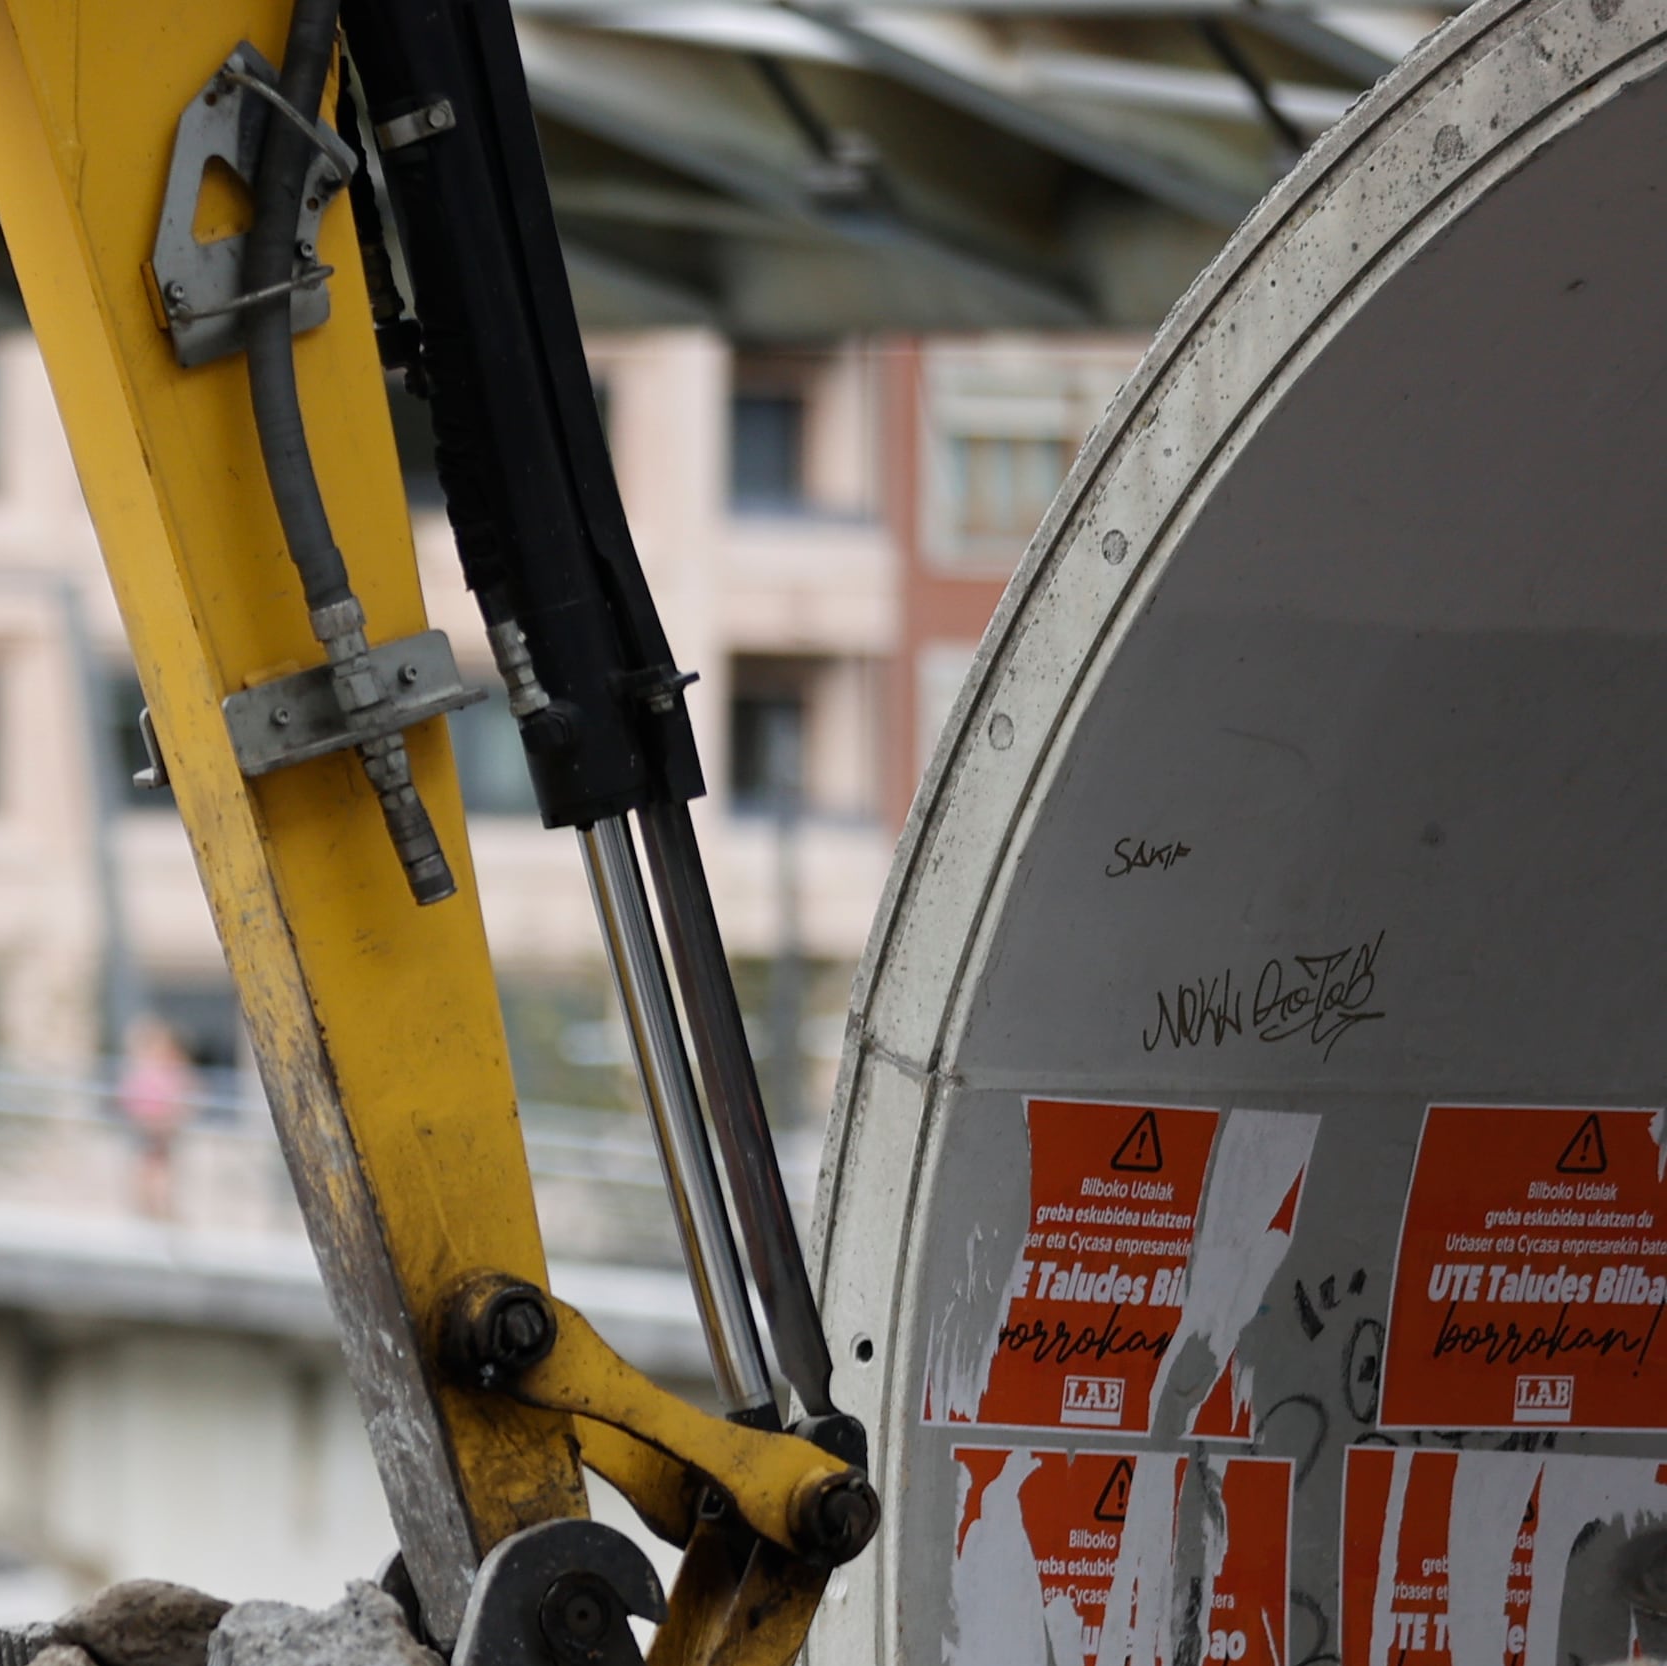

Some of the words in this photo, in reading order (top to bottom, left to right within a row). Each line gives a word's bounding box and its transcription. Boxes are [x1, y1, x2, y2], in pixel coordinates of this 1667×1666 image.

[1080, 1177, 1129, 1199] Bilboko
[1130, 1180, 1174, 1200] Udalak
[1527, 1181, 1572, 1200] Bilboko
[1576, 1182, 1618, 1201] Udalak
[1036, 1203, 1073, 1225] greba
[1075, 1205, 1139, 1227] eskubidea
[1142, 1208, 1191, 1229] ukatzen
[1485, 1208, 1521, 1230] greba
[1522, 1208, 1585, 1227] eskubidea
[1586, 1211, 1635, 1228] ukatzen
[1636, 1210, 1654, 1228] du
[1046, 1233, 1067, 1249] eta
[1069, 1231, 1112, 1256] Cycasa
[1445, 1233, 1493, 1252] Urbaser
[1496, 1236, 1515, 1252] eta
[1517, 1234, 1560, 1256] Cycasa
[1562, 1237, 1639, 1257] enpresarekin
[1035, 1261, 1148, 1306] Taludes
[1428, 1263, 1485, 1302] UTE
[1486, 1264, 1593, 1304] Taludes
[1594, 1265, 1667, 1306] Bilba
[999, 1304, 1174, 1364] orroka
[1066, 1381, 1121, 1410] LAB
[1517, 1380, 1570, 1406] LAB
[1068, 1529, 1117, 1549] Bilboko
[1036, 1555, 1066, 1576] reba
[1394, 1582, 1433, 1601] rbaser
[1396, 1612, 1430, 1651] TE
